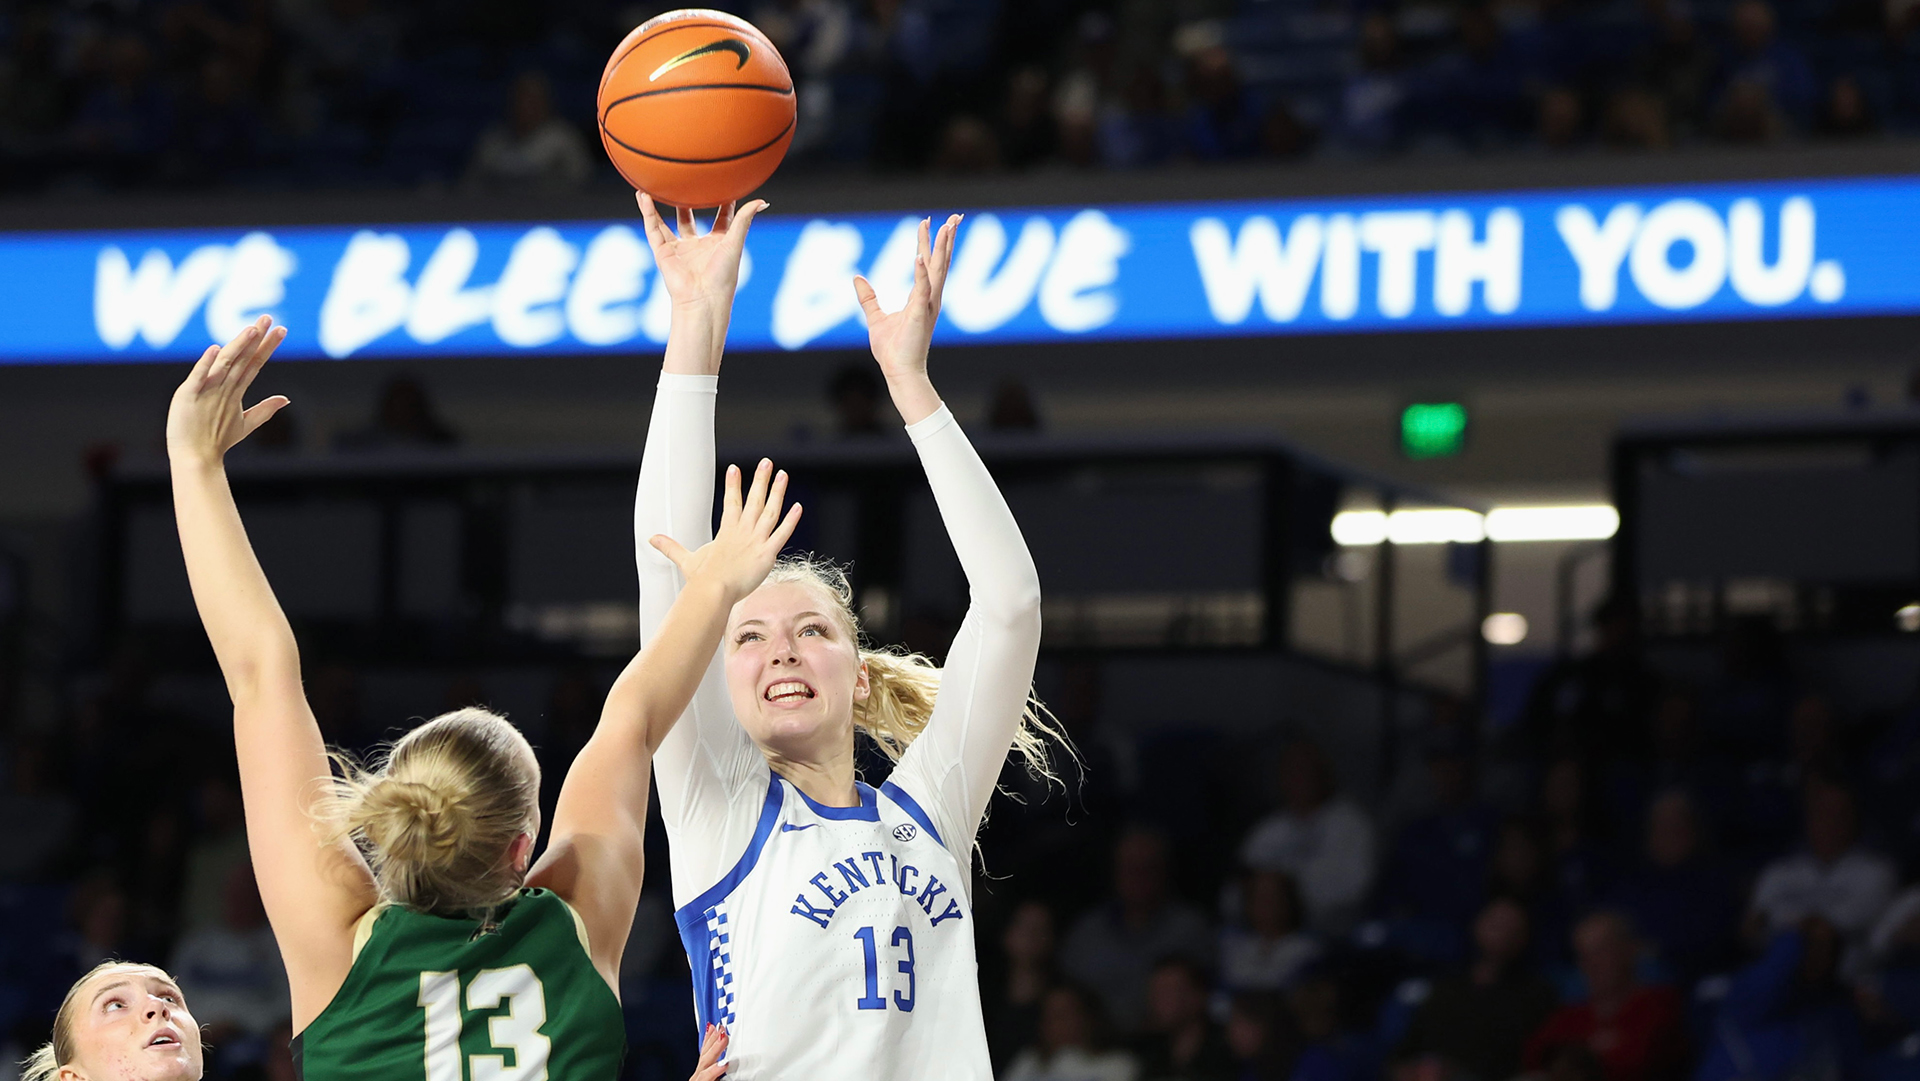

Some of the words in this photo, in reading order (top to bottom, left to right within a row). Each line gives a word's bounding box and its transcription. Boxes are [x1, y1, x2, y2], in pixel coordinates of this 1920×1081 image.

[93, 231, 297, 350] WE
[771, 209, 1130, 350] BLUE
[1191, 207, 1523, 324] WITH
[1557, 196, 1846, 312] YOU.
[893, 824, 917, 842] SEC
[853, 926, 916, 1012] 13
[417, 963, 552, 1081] 13
